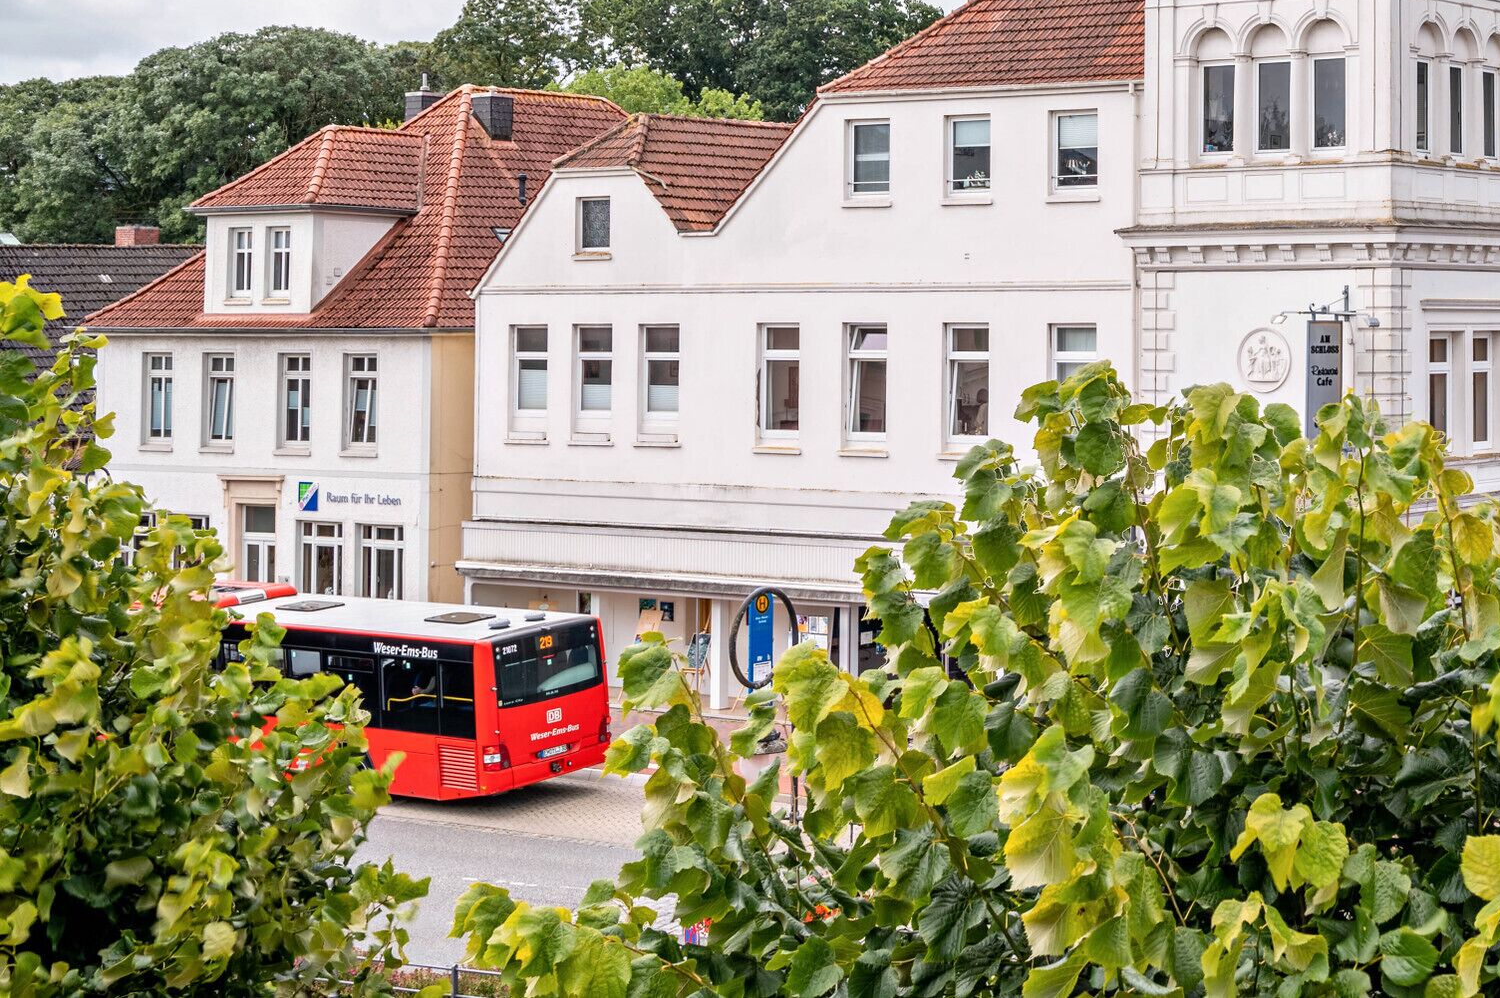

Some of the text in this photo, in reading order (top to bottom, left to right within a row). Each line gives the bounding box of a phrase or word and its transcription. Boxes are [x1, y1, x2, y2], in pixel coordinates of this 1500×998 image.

[1320, 335, 1331, 343] AM
[1310, 345, 1339, 354] SCHLOSS
[326, 491, 349, 504] Raum
[351, 492, 363, 504] für
[364, 493, 375, 504] Ihr
[377, 494, 402, 506] Leben
[373, 641, 438, 659] Weser-Ems-Bus
[502, 644, 518, 655] 21072
[548, 710, 560, 721] DB
[530, 723, 580, 741] Weser-Ems-Bus
